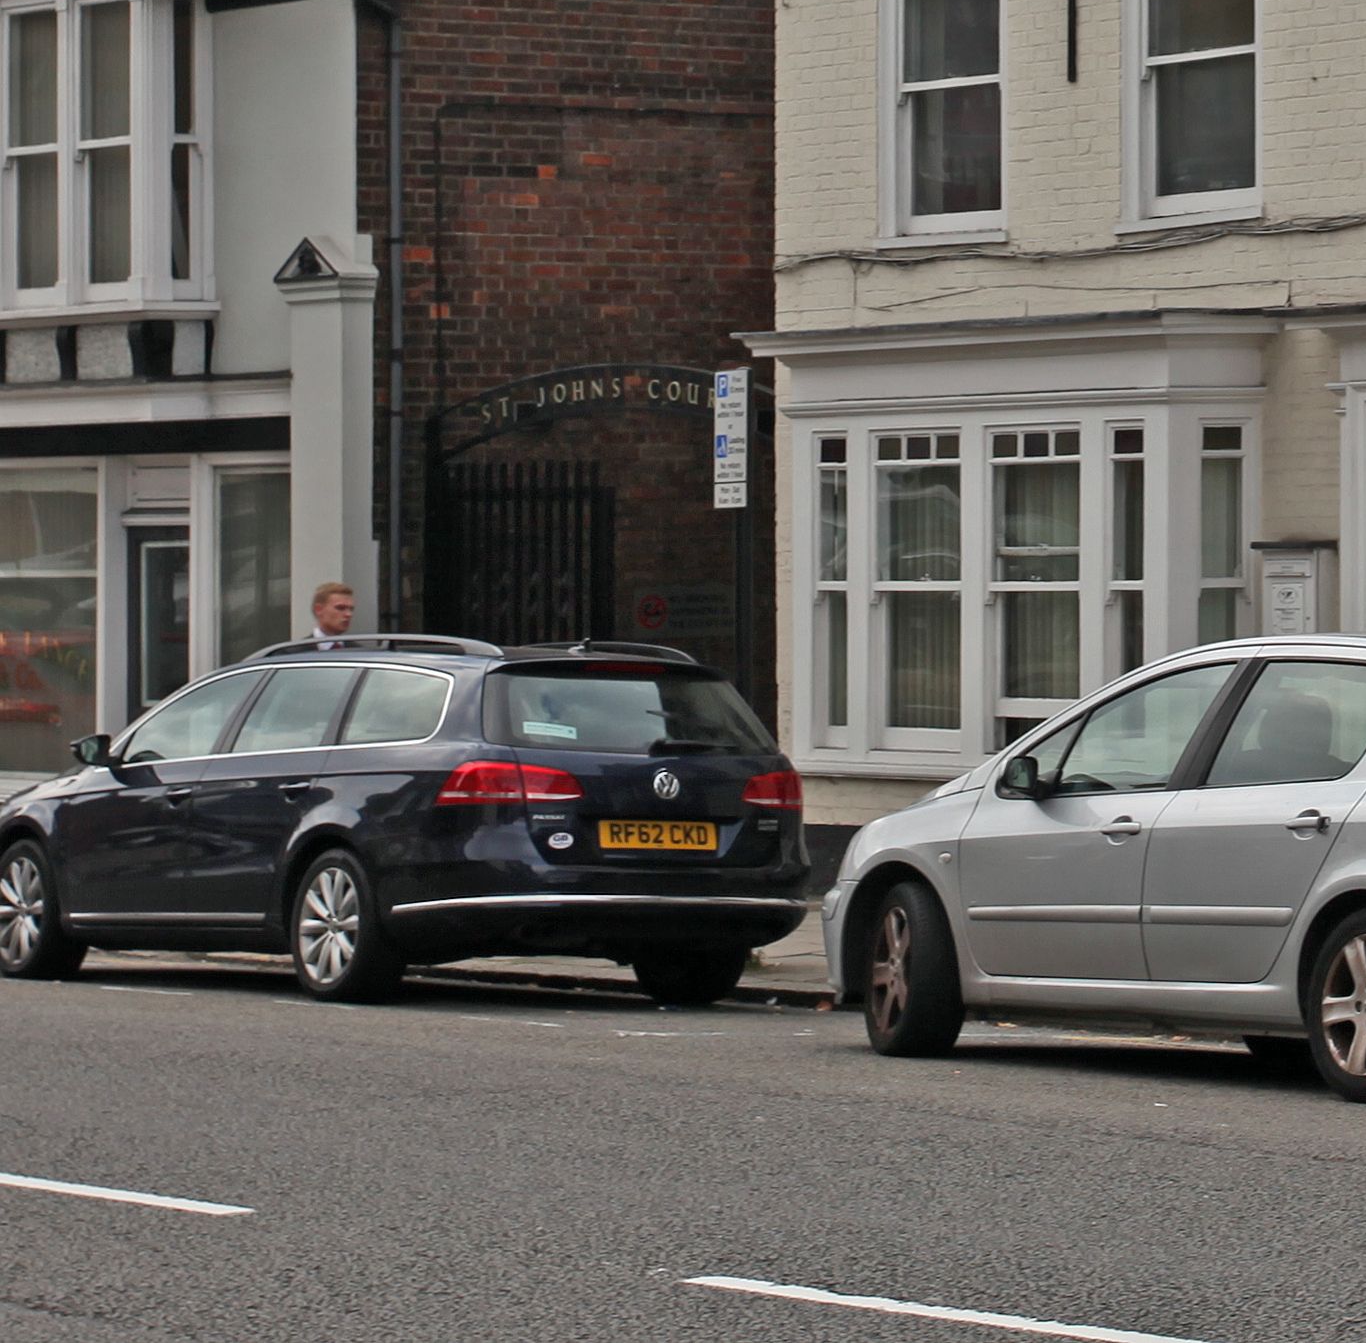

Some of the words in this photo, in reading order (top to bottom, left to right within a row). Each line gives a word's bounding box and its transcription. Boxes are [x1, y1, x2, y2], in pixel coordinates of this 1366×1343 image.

[481, 397, 509, 424] ST
[536, 377, 621, 407] JOHNS
[647, 379, 716, 408] COUR
[609, 823, 665, 845] RF62
[670, 824, 708, 845] CKD
